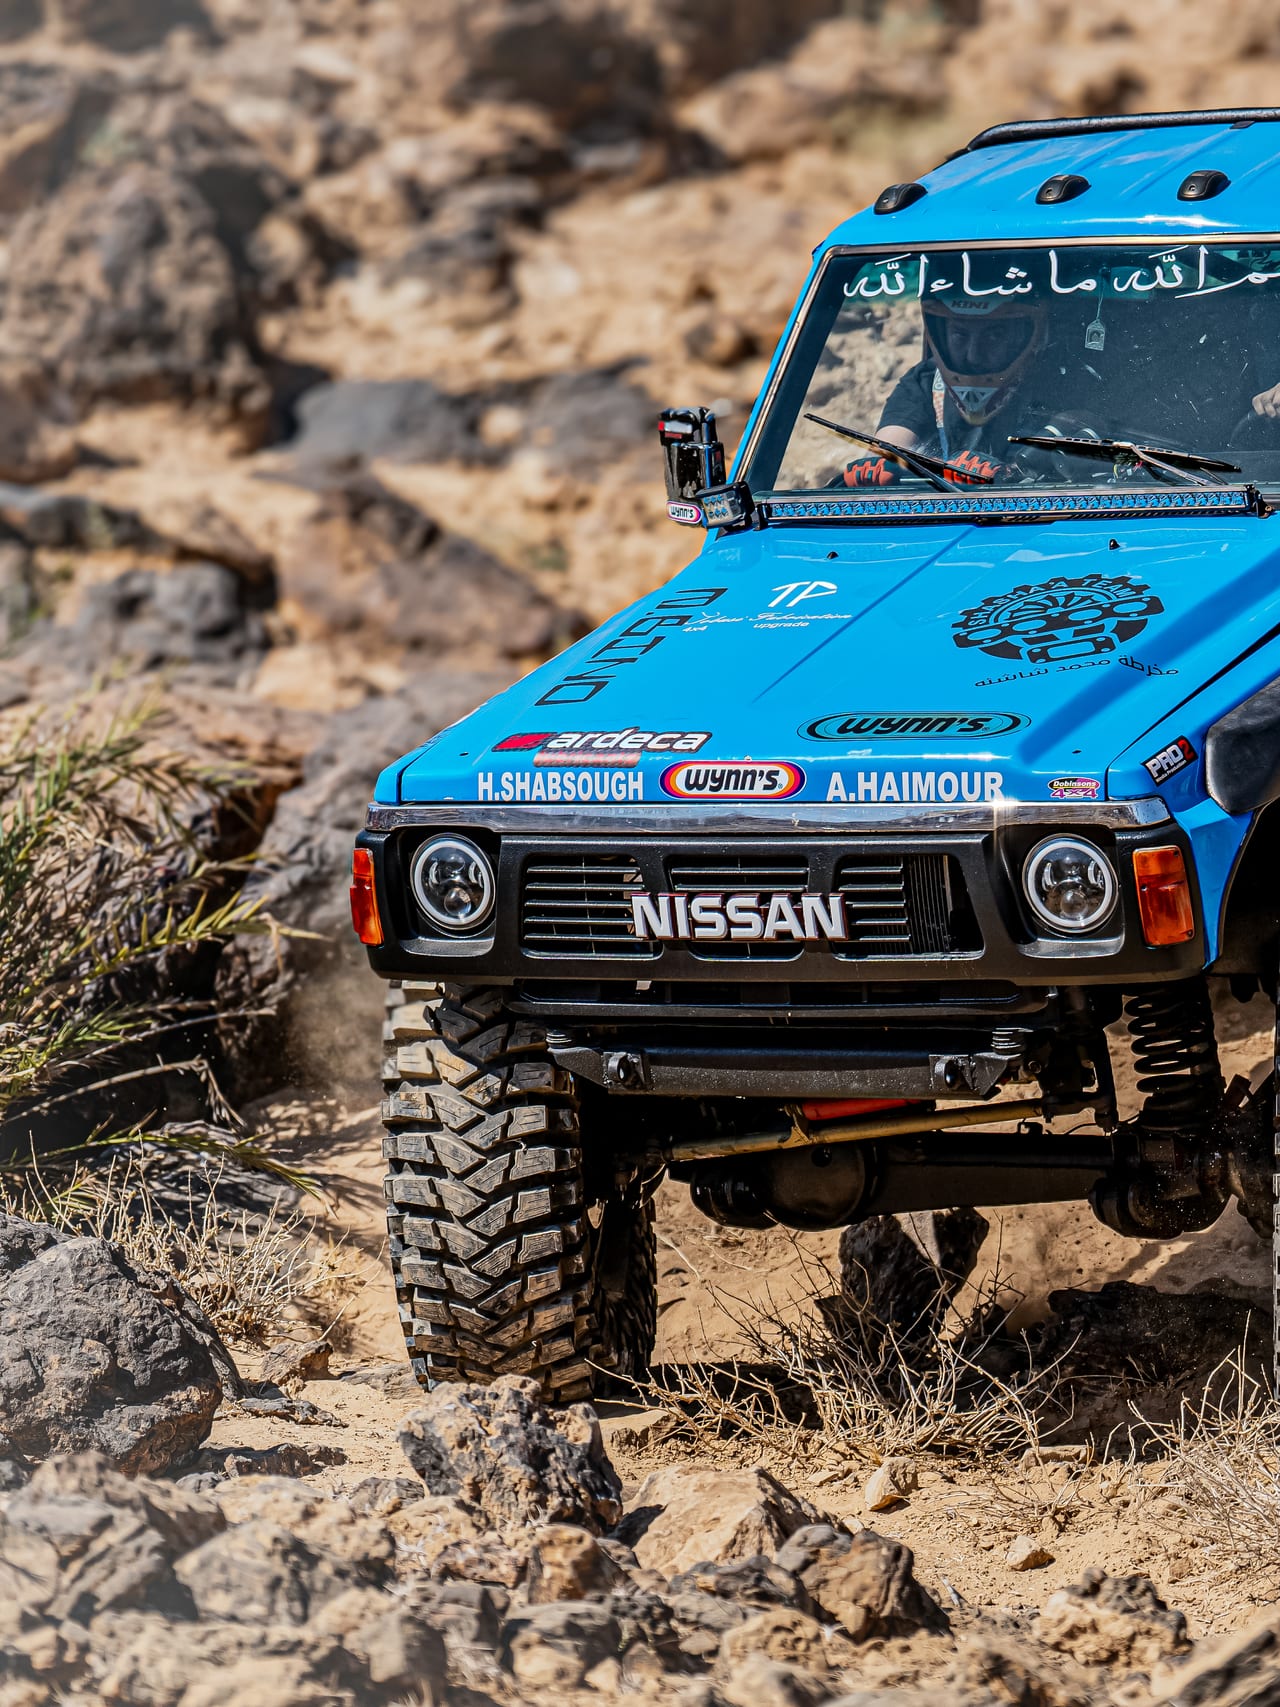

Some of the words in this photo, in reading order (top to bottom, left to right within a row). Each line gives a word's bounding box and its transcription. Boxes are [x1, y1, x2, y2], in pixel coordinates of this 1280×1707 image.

[929, 251, 1032, 298] شاء
[1049, 250, 1097, 293] ما
[768, 581, 838, 607] TP
[967, 580, 1069, 626] SHASHA'A
[1081, 577, 1136, 598] TEAM
[753, 621, 810, 630] upgrade
[1055, 659, 1111, 673] محمد
[547, 727, 709, 751] ardeca
[478, 771, 644, 801] H.SHABSOUGH
[826, 771, 1005, 802] A.HAIMOUR
[629, 892, 850, 942] NISSAN
